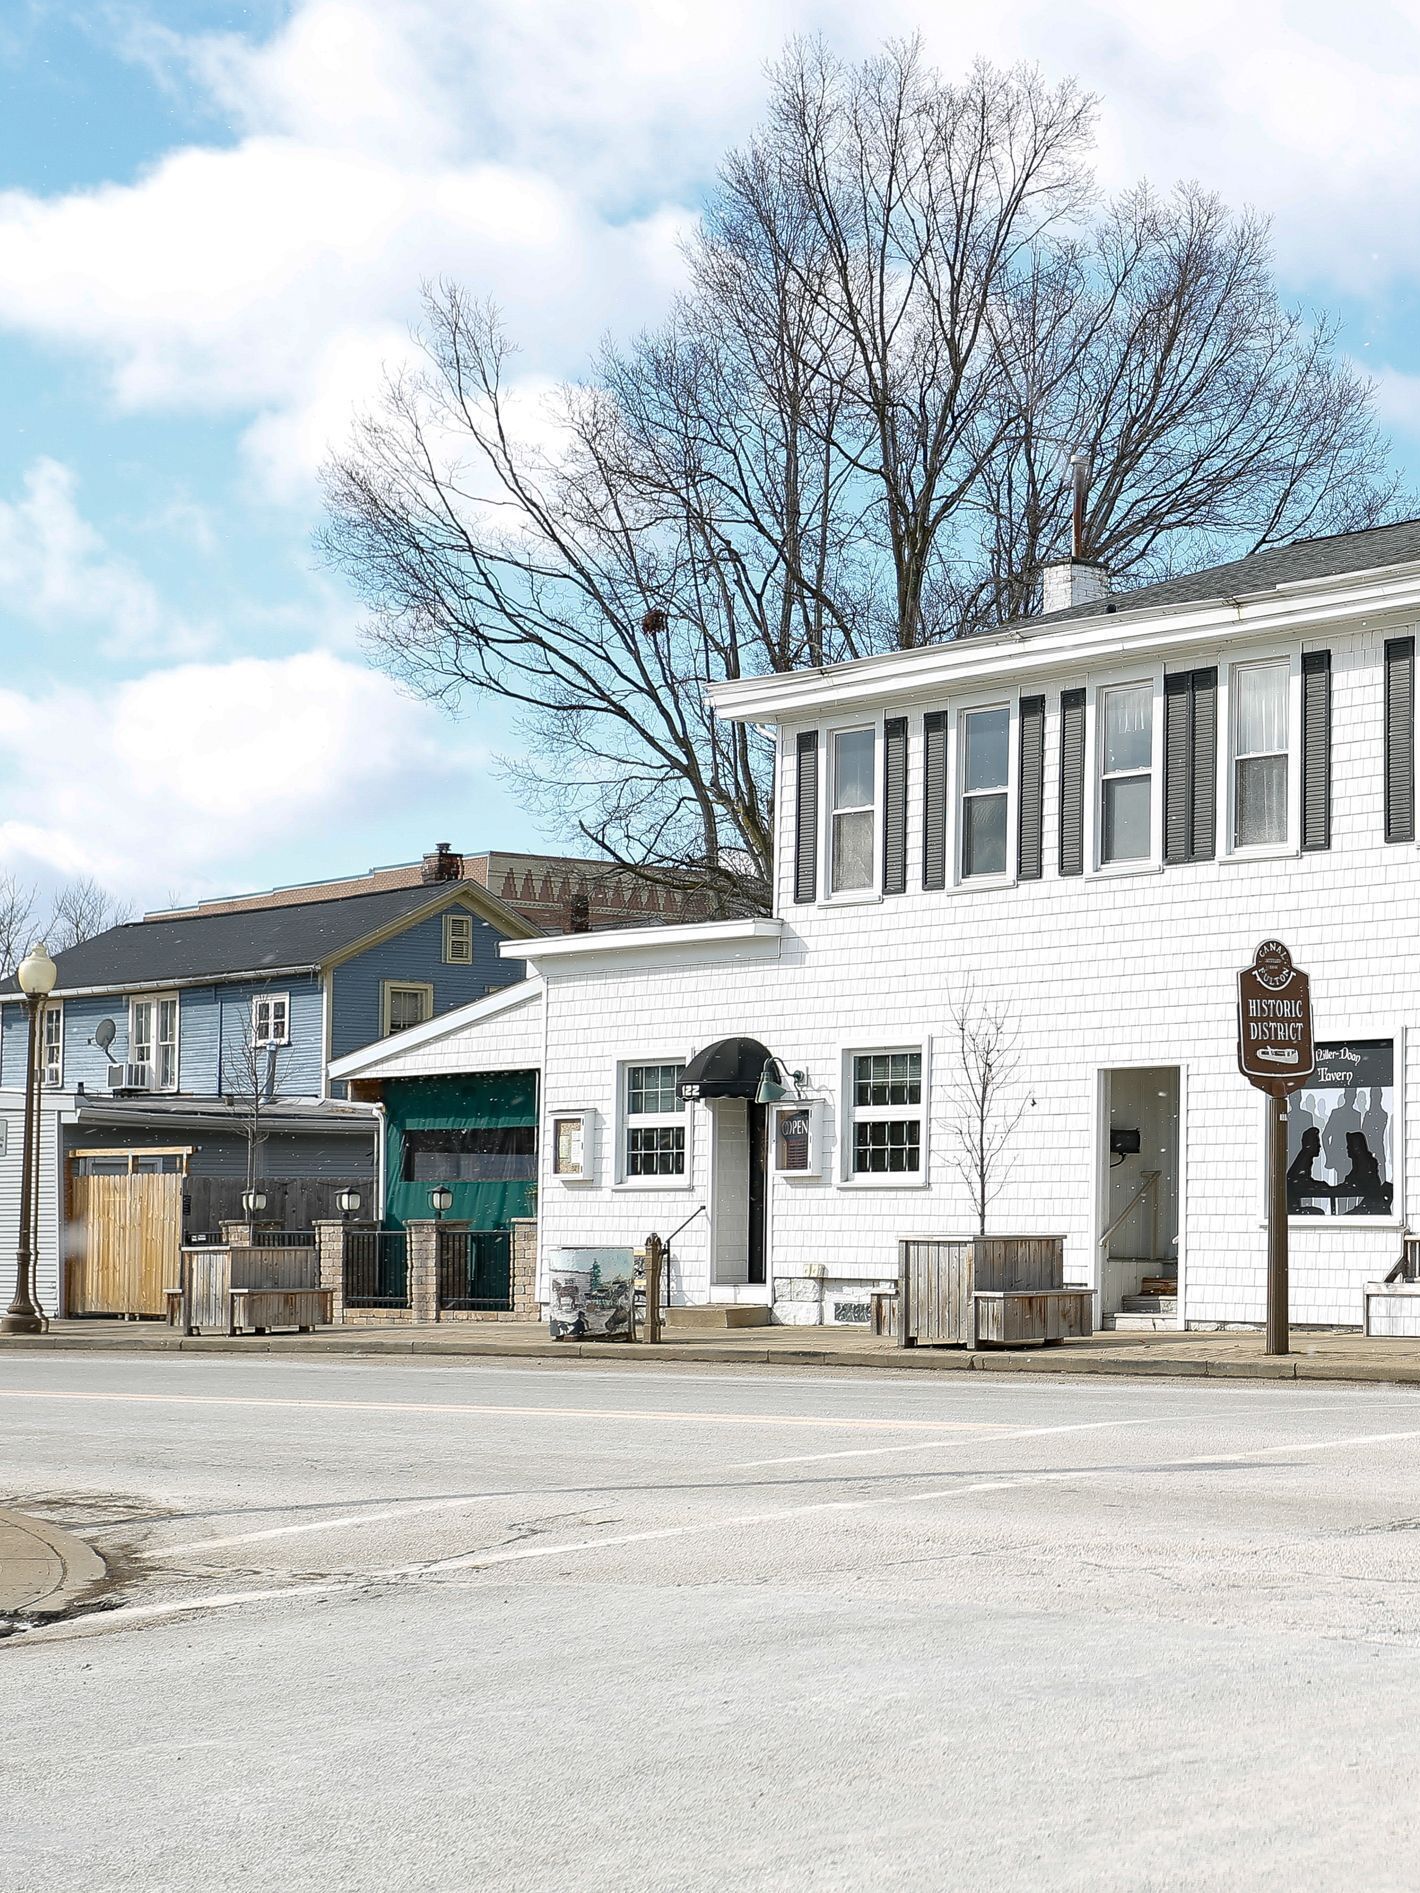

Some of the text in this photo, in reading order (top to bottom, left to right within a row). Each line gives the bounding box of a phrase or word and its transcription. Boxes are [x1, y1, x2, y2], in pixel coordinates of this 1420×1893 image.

[1259, 943, 1287, 960] CANAL
[1259, 967, 1290, 986] FULTON
[1248, 999, 1303, 1018] HISTORIC
[1249, 1022, 1304, 1041] DISTRICT
[1317, 1067, 1354, 1086] Tavern
[682, 1085, 700, 1096] 122
[782, 1119, 808, 1136] OPEN
